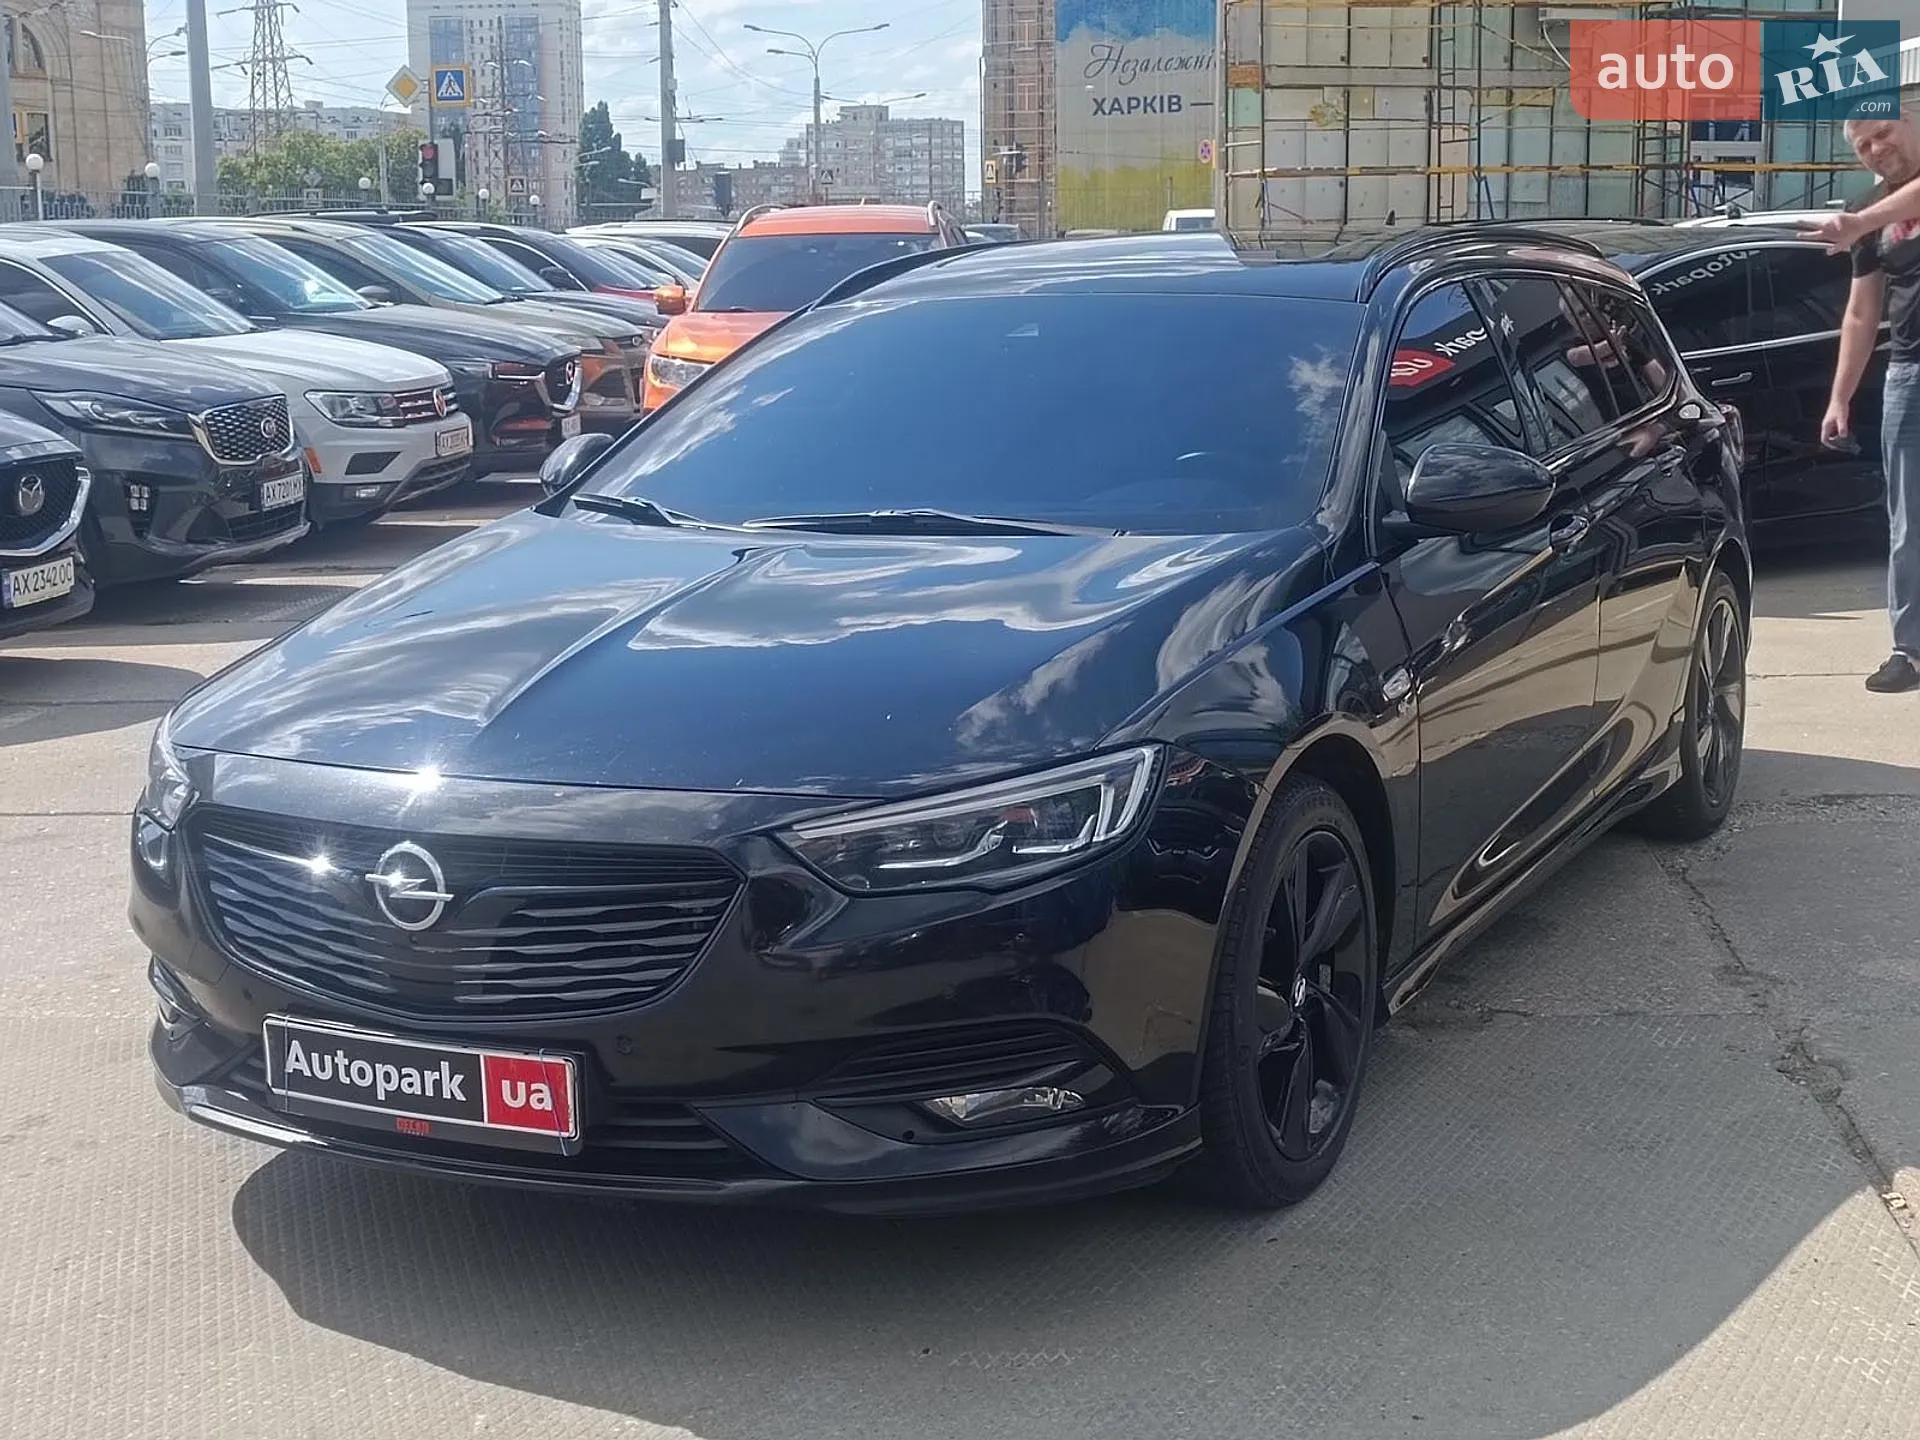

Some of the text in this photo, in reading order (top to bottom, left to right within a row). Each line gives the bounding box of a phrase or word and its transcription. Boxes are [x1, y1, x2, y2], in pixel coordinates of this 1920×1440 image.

[1083, 44, 1217, 86] Незалежні
[1092, 94, 1182, 117] ХАРКІВ
[13, 573, 31, 596] AX
[33, 566, 58, 592] 2342
[285, 1039, 553, 1111] Autopark ua
